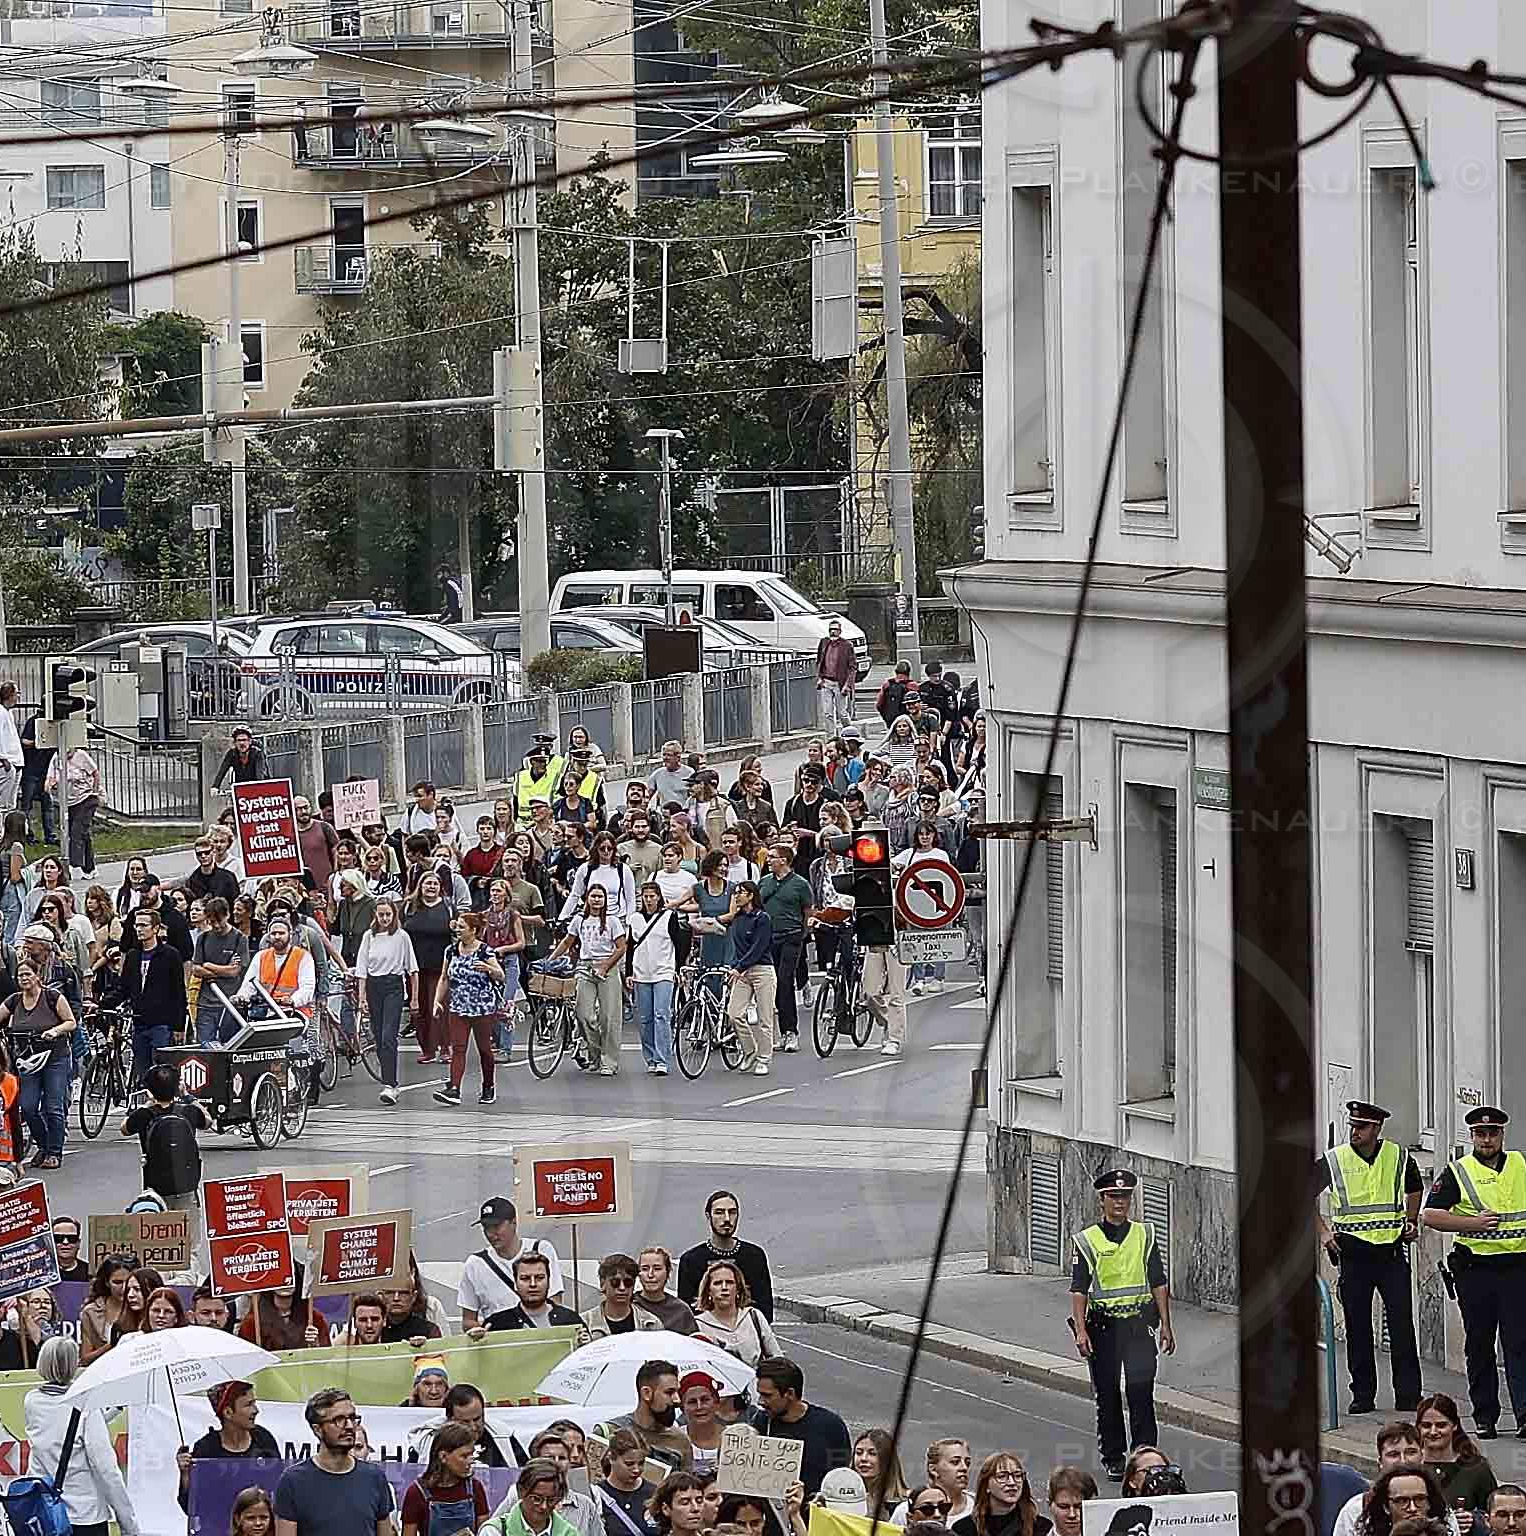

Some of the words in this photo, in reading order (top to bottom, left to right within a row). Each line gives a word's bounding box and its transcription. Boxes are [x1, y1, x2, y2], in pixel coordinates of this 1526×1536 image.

[341, 783, 367, 797] FUCK
[238, 794, 288, 812] System-
[241, 805, 290, 824] wechsel
[255, 822, 280, 834] statt
[249, 834, 290, 850] Klima-
[1457, 853, 1468, 874] 38
[901, 932, 962, 942] Ausgenommen
[923, 942, 941, 951] Taxi
[545, 1174, 577, 1183] THERE
[577, 1173, 586, 1181] IS
[587, 1171, 603, 1180] NO
[224, 1184, 249, 1194] Unser
[225, 1191, 256, 1203] Wasser
[286, 1198, 338, 1209] PRIVATJETS
[553, 1192, 590, 1203] PLANET
[590, 1192, 598, 1200] B
[226, 1202, 248, 1212] muss
[287, 1208, 338, 1219] VERBIETEN!
[226, 1208, 266, 1221] öffentlich
[31, 1221, 50, 1235] SPÖ
[140, 1214, 188, 1241] brennt
[227, 1218, 261, 1230] bleiben!
[266, 1217, 287, 1230] SPÖ
[342, 1228, 378, 1240] SYSTEM
[339, 1239, 378, 1250] CHANGE
[143, 1240, 186, 1267] pennt
[223, 1250, 280, 1266] PRIVATJETS
[349, 1248, 369, 1259] NOT
[224, 1261, 280, 1276] VERBIETEN!
[339, 1257, 378, 1269] CLIMATE
[338, 1266, 376, 1279] CHANGE
[725, 1433, 752, 1449] THIS
[759, 1439, 770, 1451] IS
[722, 1450, 755, 1466] SIGN
[773, 1459, 798, 1473] GO
[1155, 1515, 1187, 1527] Friend
[1189, 1513, 1220, 1525] Inside
[1222, 1512, 1237, 1522] Me
